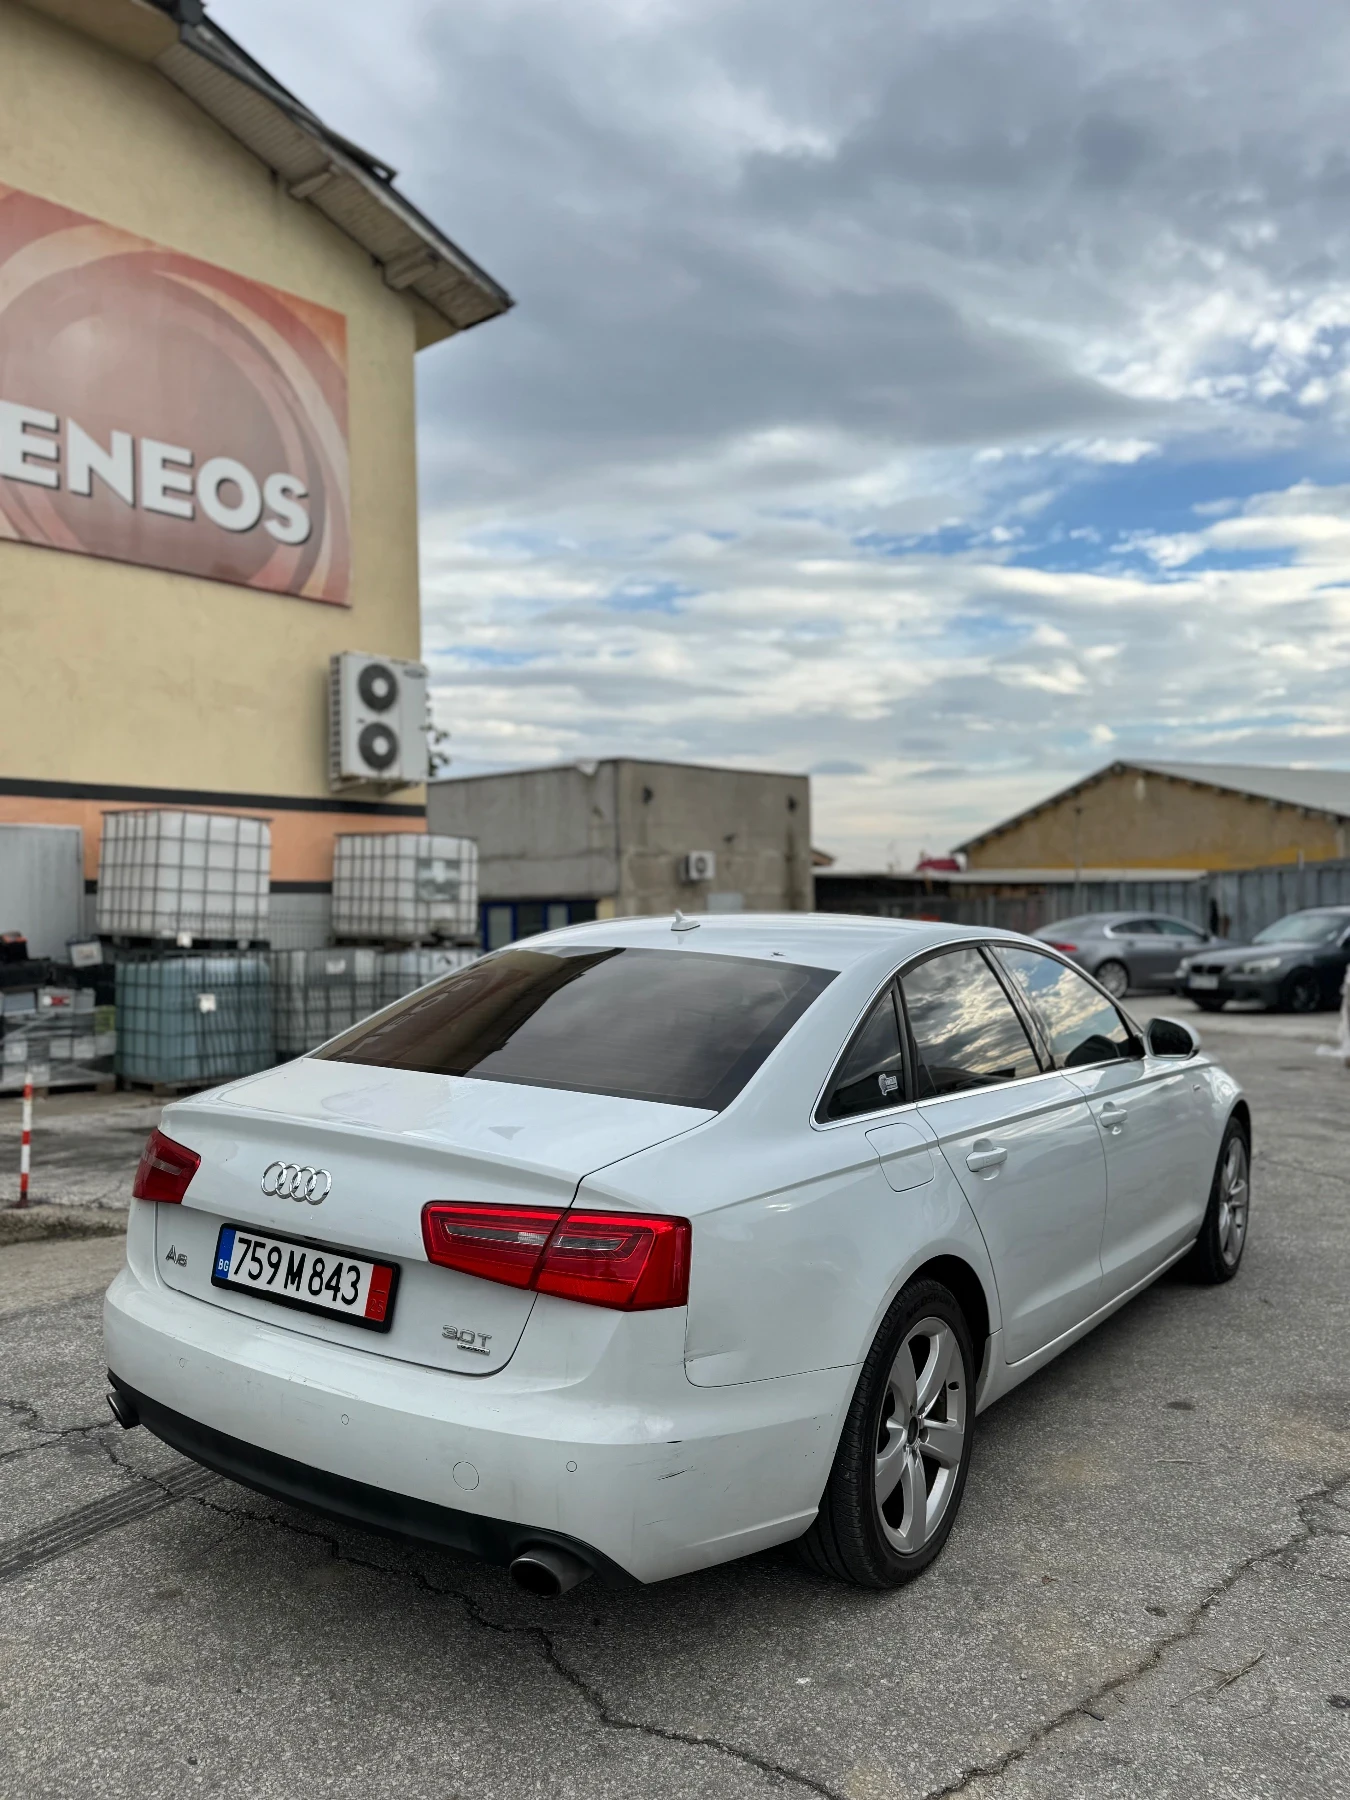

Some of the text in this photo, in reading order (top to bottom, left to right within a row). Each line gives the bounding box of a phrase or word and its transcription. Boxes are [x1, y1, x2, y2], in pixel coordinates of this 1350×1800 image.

[0, 399, 311, 545] ENEOS
[165, 1245, 187, 1267] A6
[217, 1258, 229, 1272] BG
